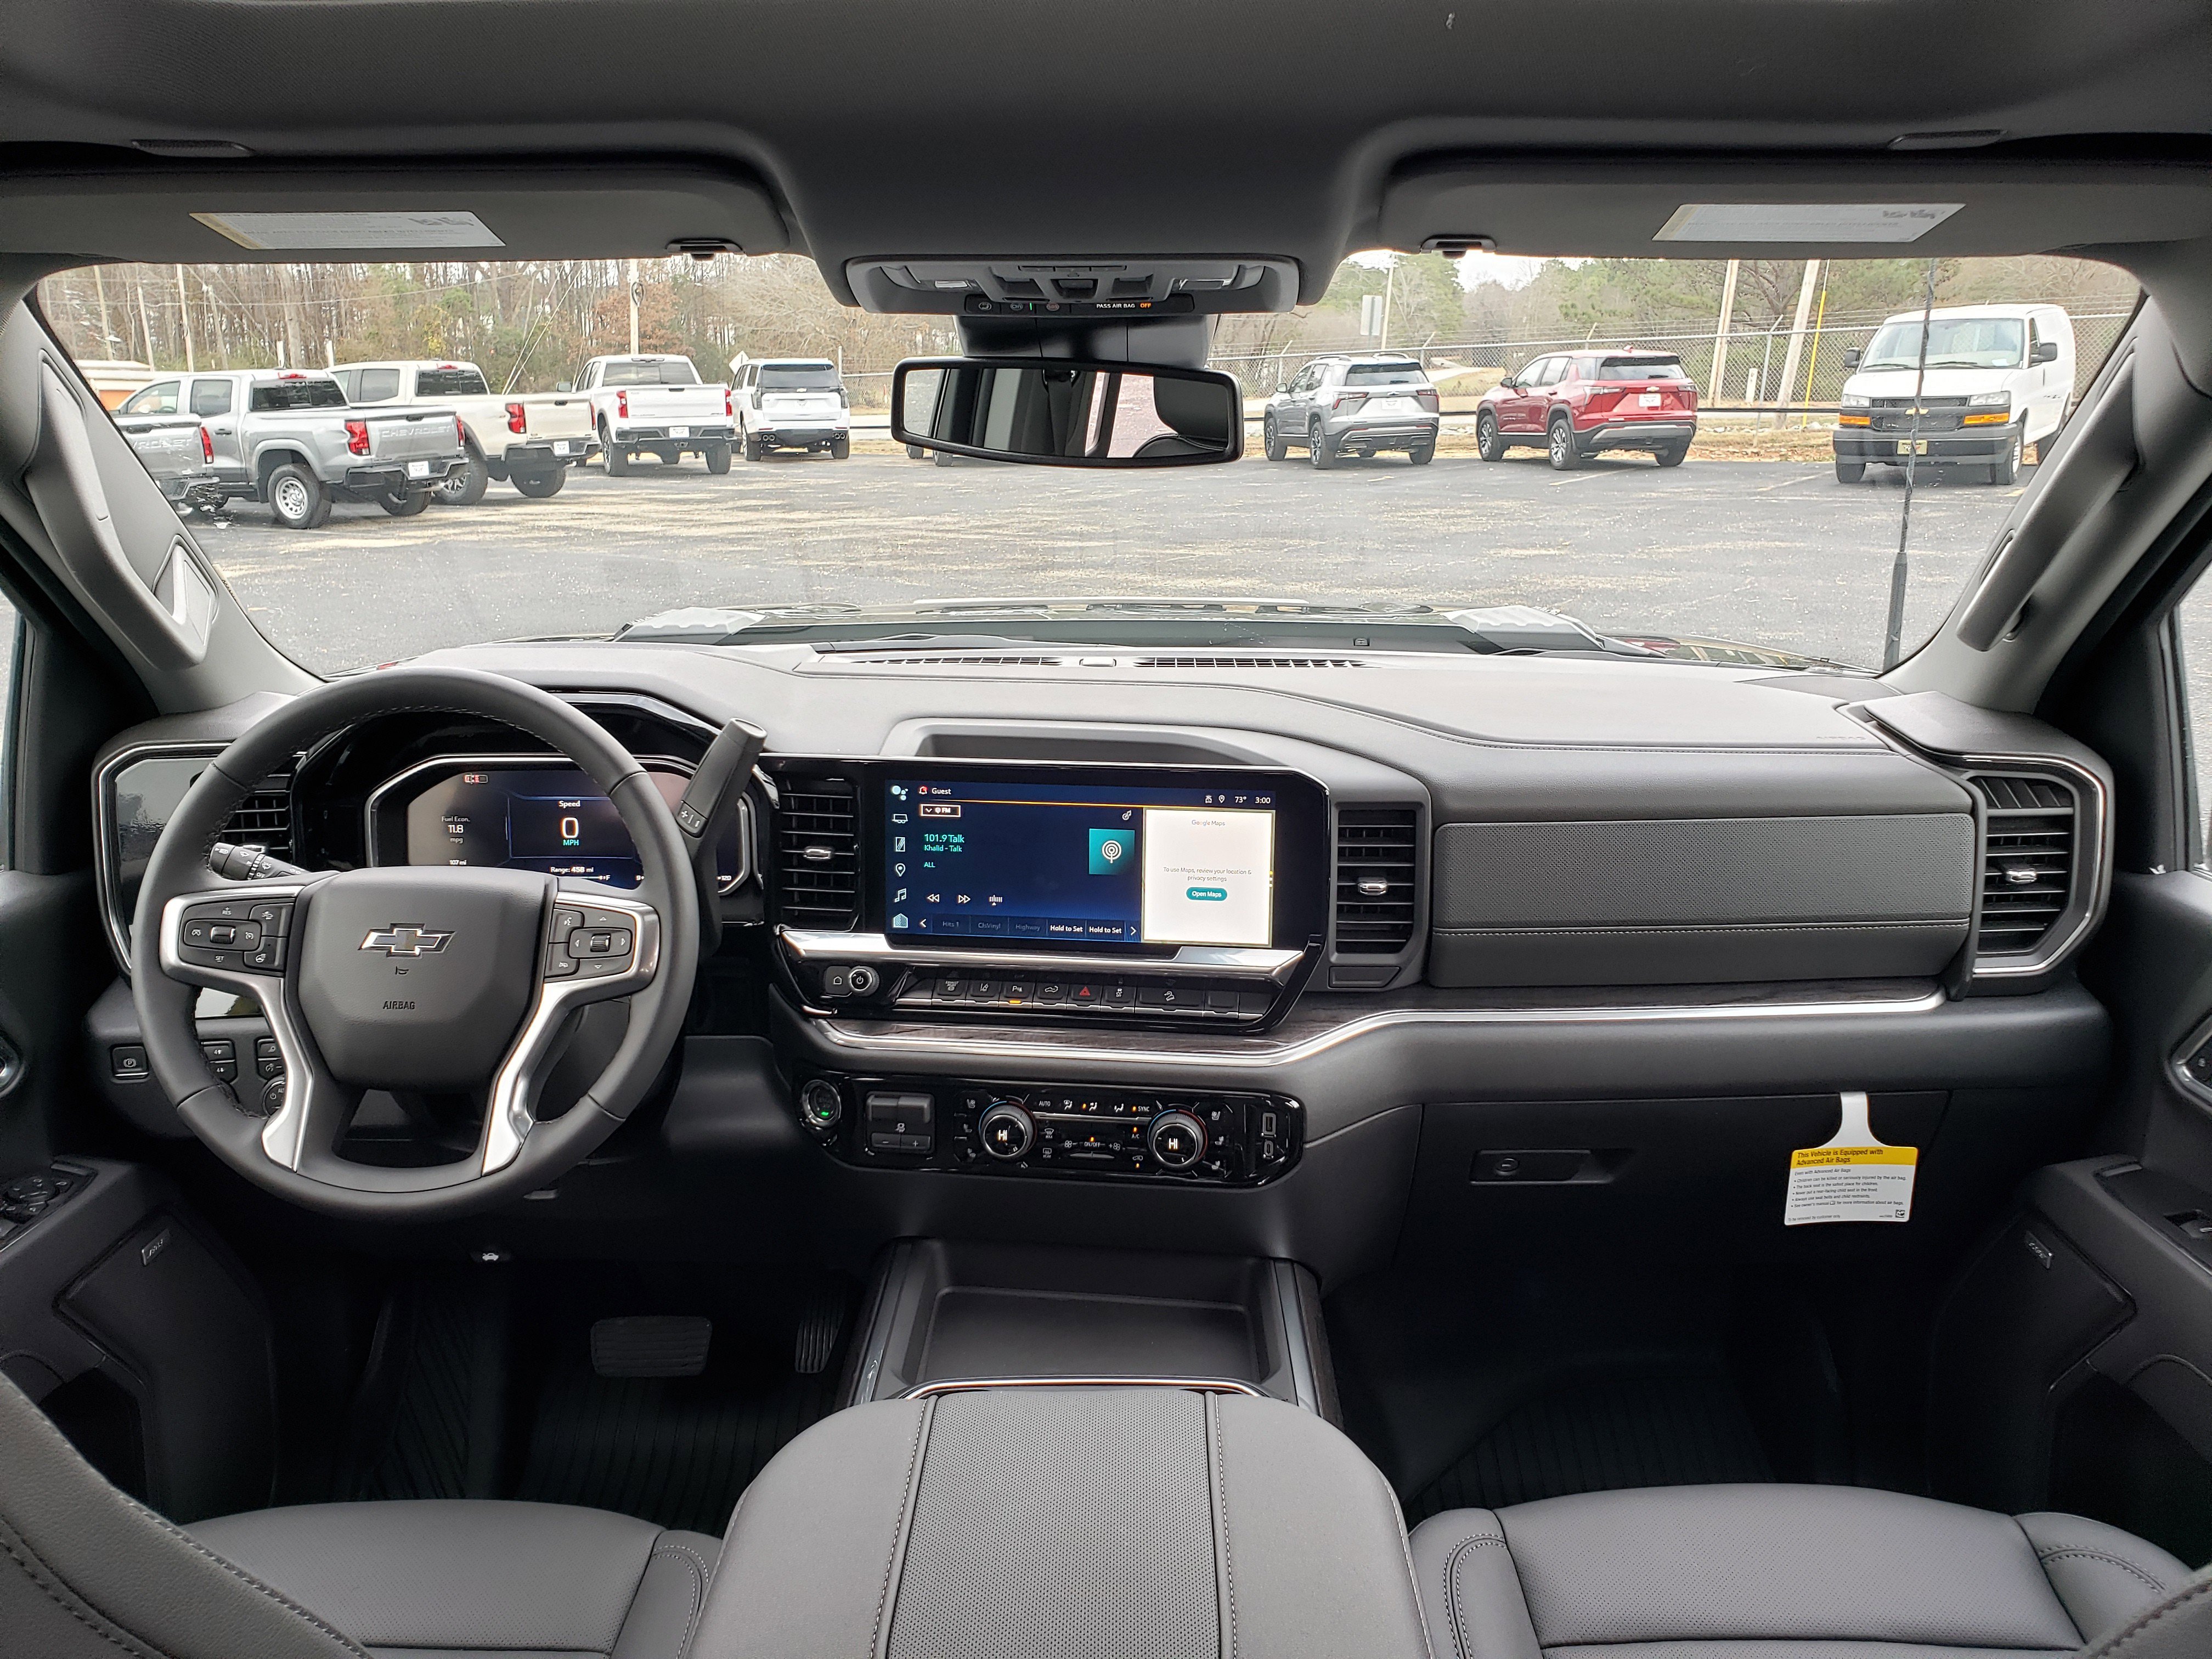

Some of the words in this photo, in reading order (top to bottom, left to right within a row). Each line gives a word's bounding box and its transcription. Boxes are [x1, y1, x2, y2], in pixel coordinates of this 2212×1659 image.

[381, 425, 451, 438] CHEVROLET
[558, 800, 581, 809] Speed
[448, 824, 464, 833] 11.8
[561, 817, 579, 839] 0
[924, 833, 947, 842] 101.9
[948, 834, 965, 843] Talk
[382, 1001, 415, 1009] AIRBAG
[998, 1130, 1007, 1141] HI
[1169, 1138, 1178, 1149] HI
[1797, 1157, 1825, 1165] Advanced
